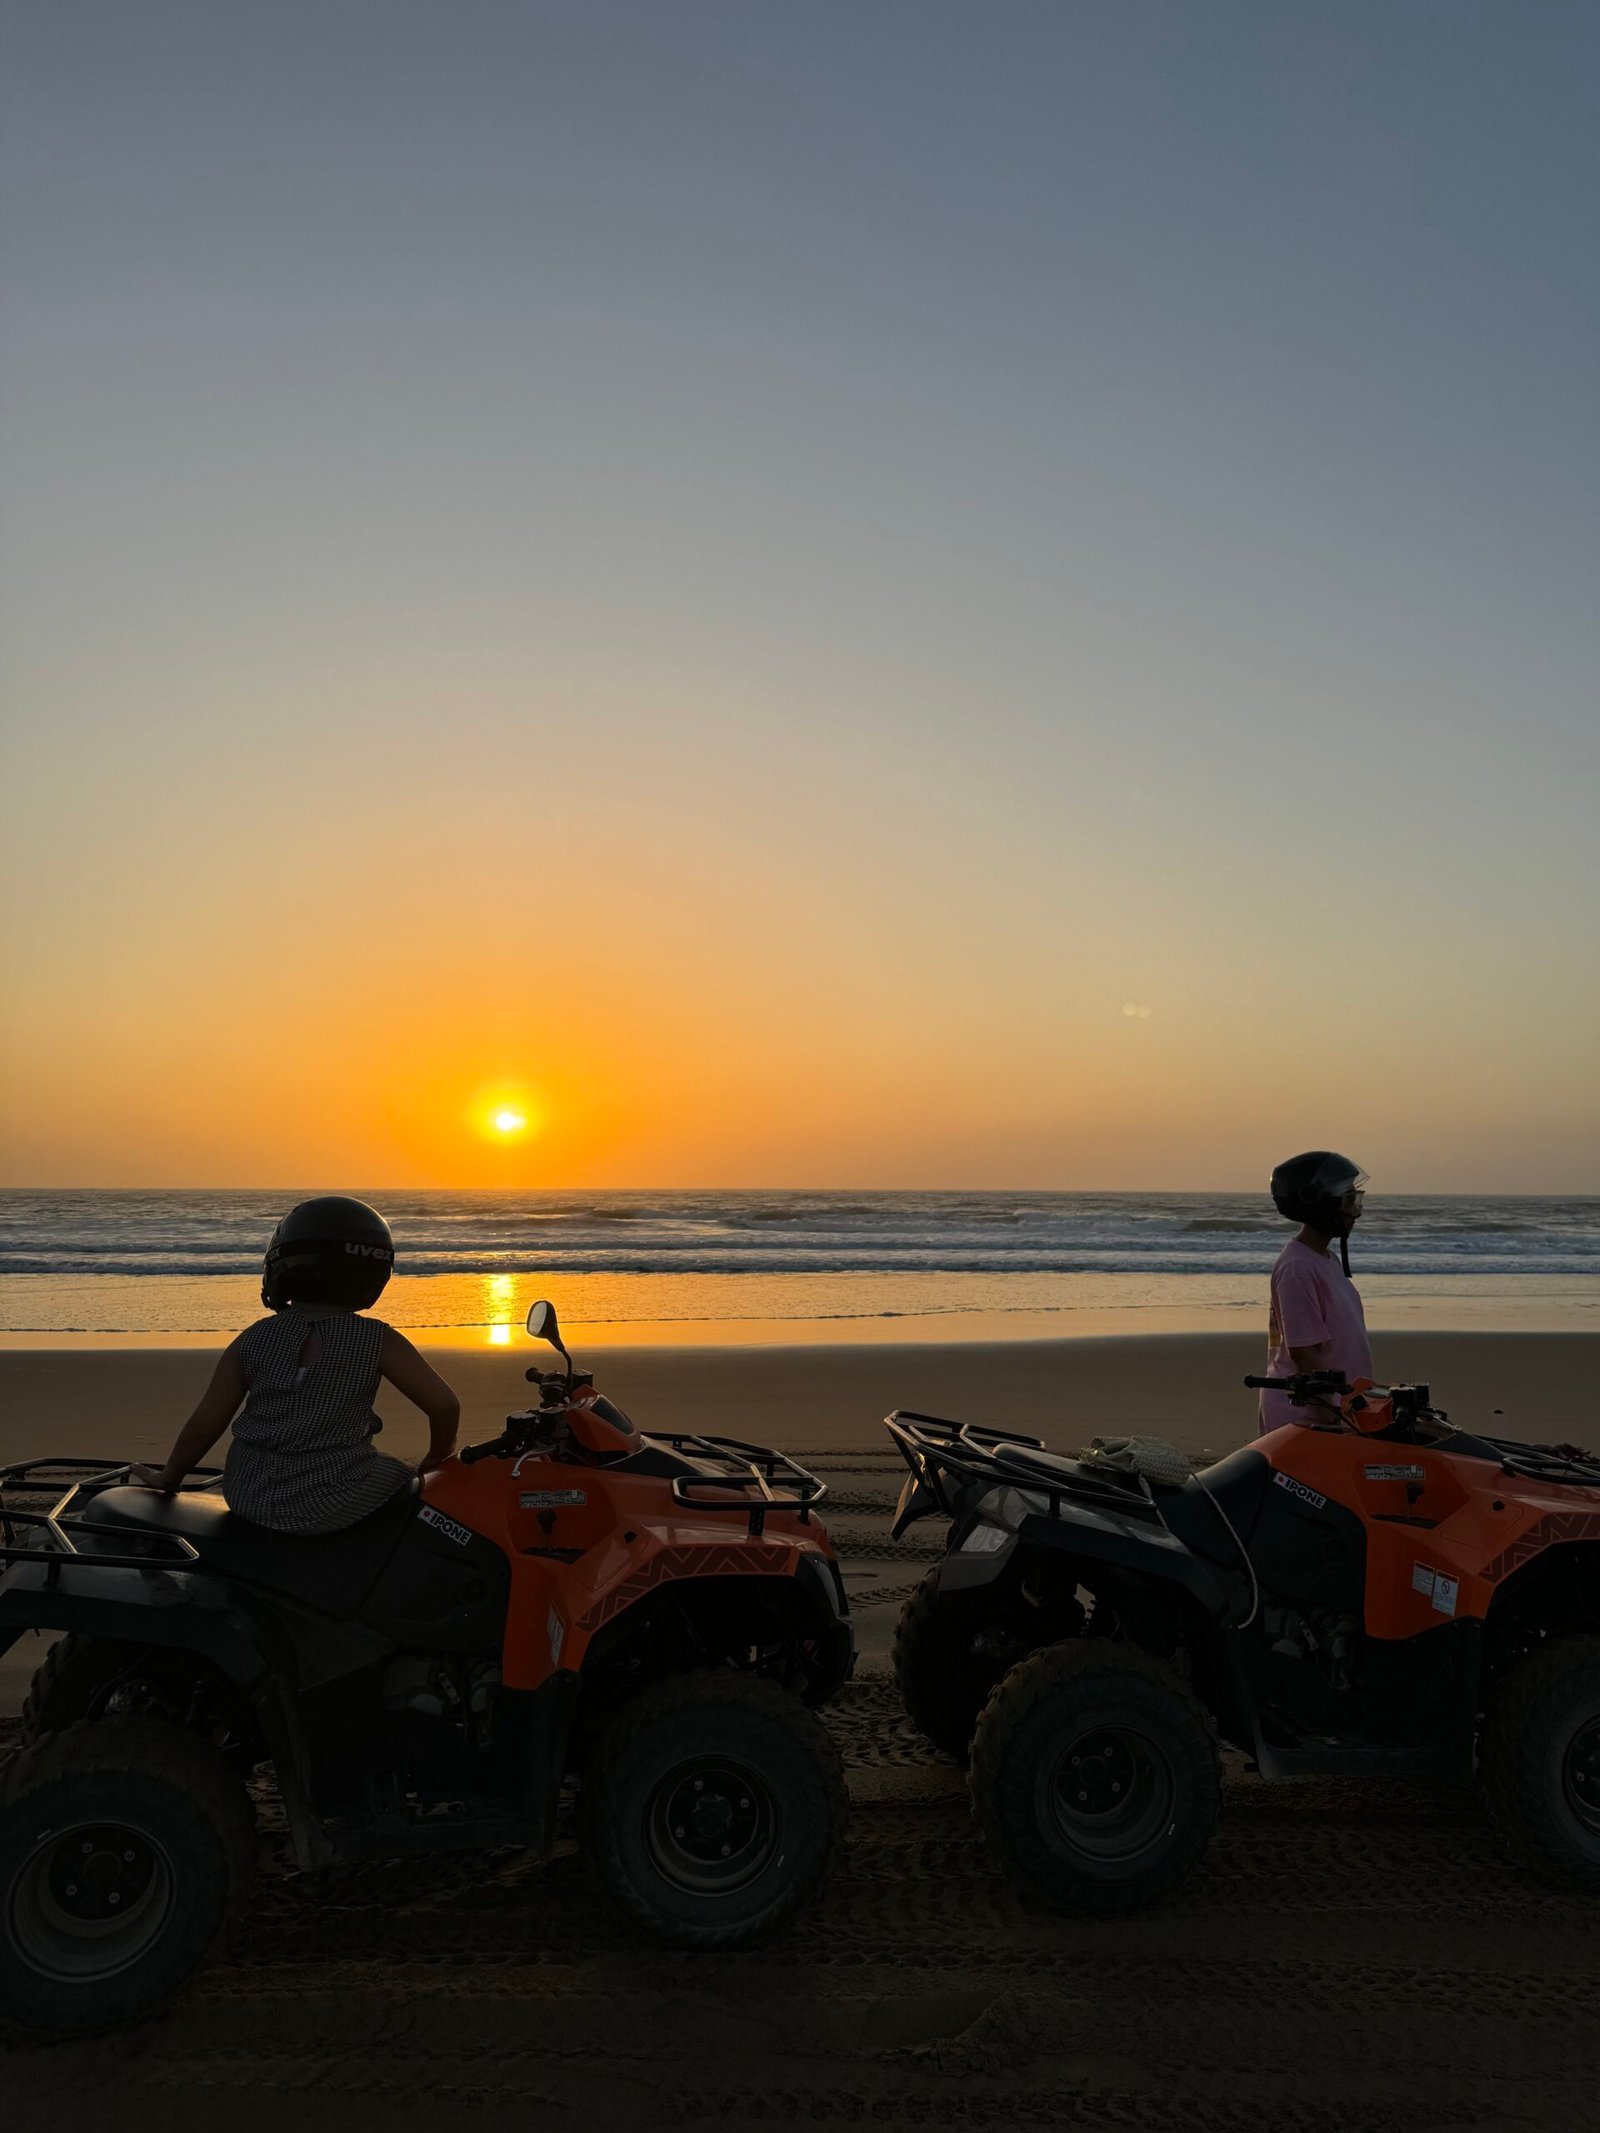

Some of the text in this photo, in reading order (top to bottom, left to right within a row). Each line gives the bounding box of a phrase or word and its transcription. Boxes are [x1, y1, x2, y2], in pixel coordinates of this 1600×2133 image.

[345, 1242, 393, 1261] uvex
[1285, 1479, 1324, 1507] IPONE
[430, 1513, 470, 1544] IPONE
